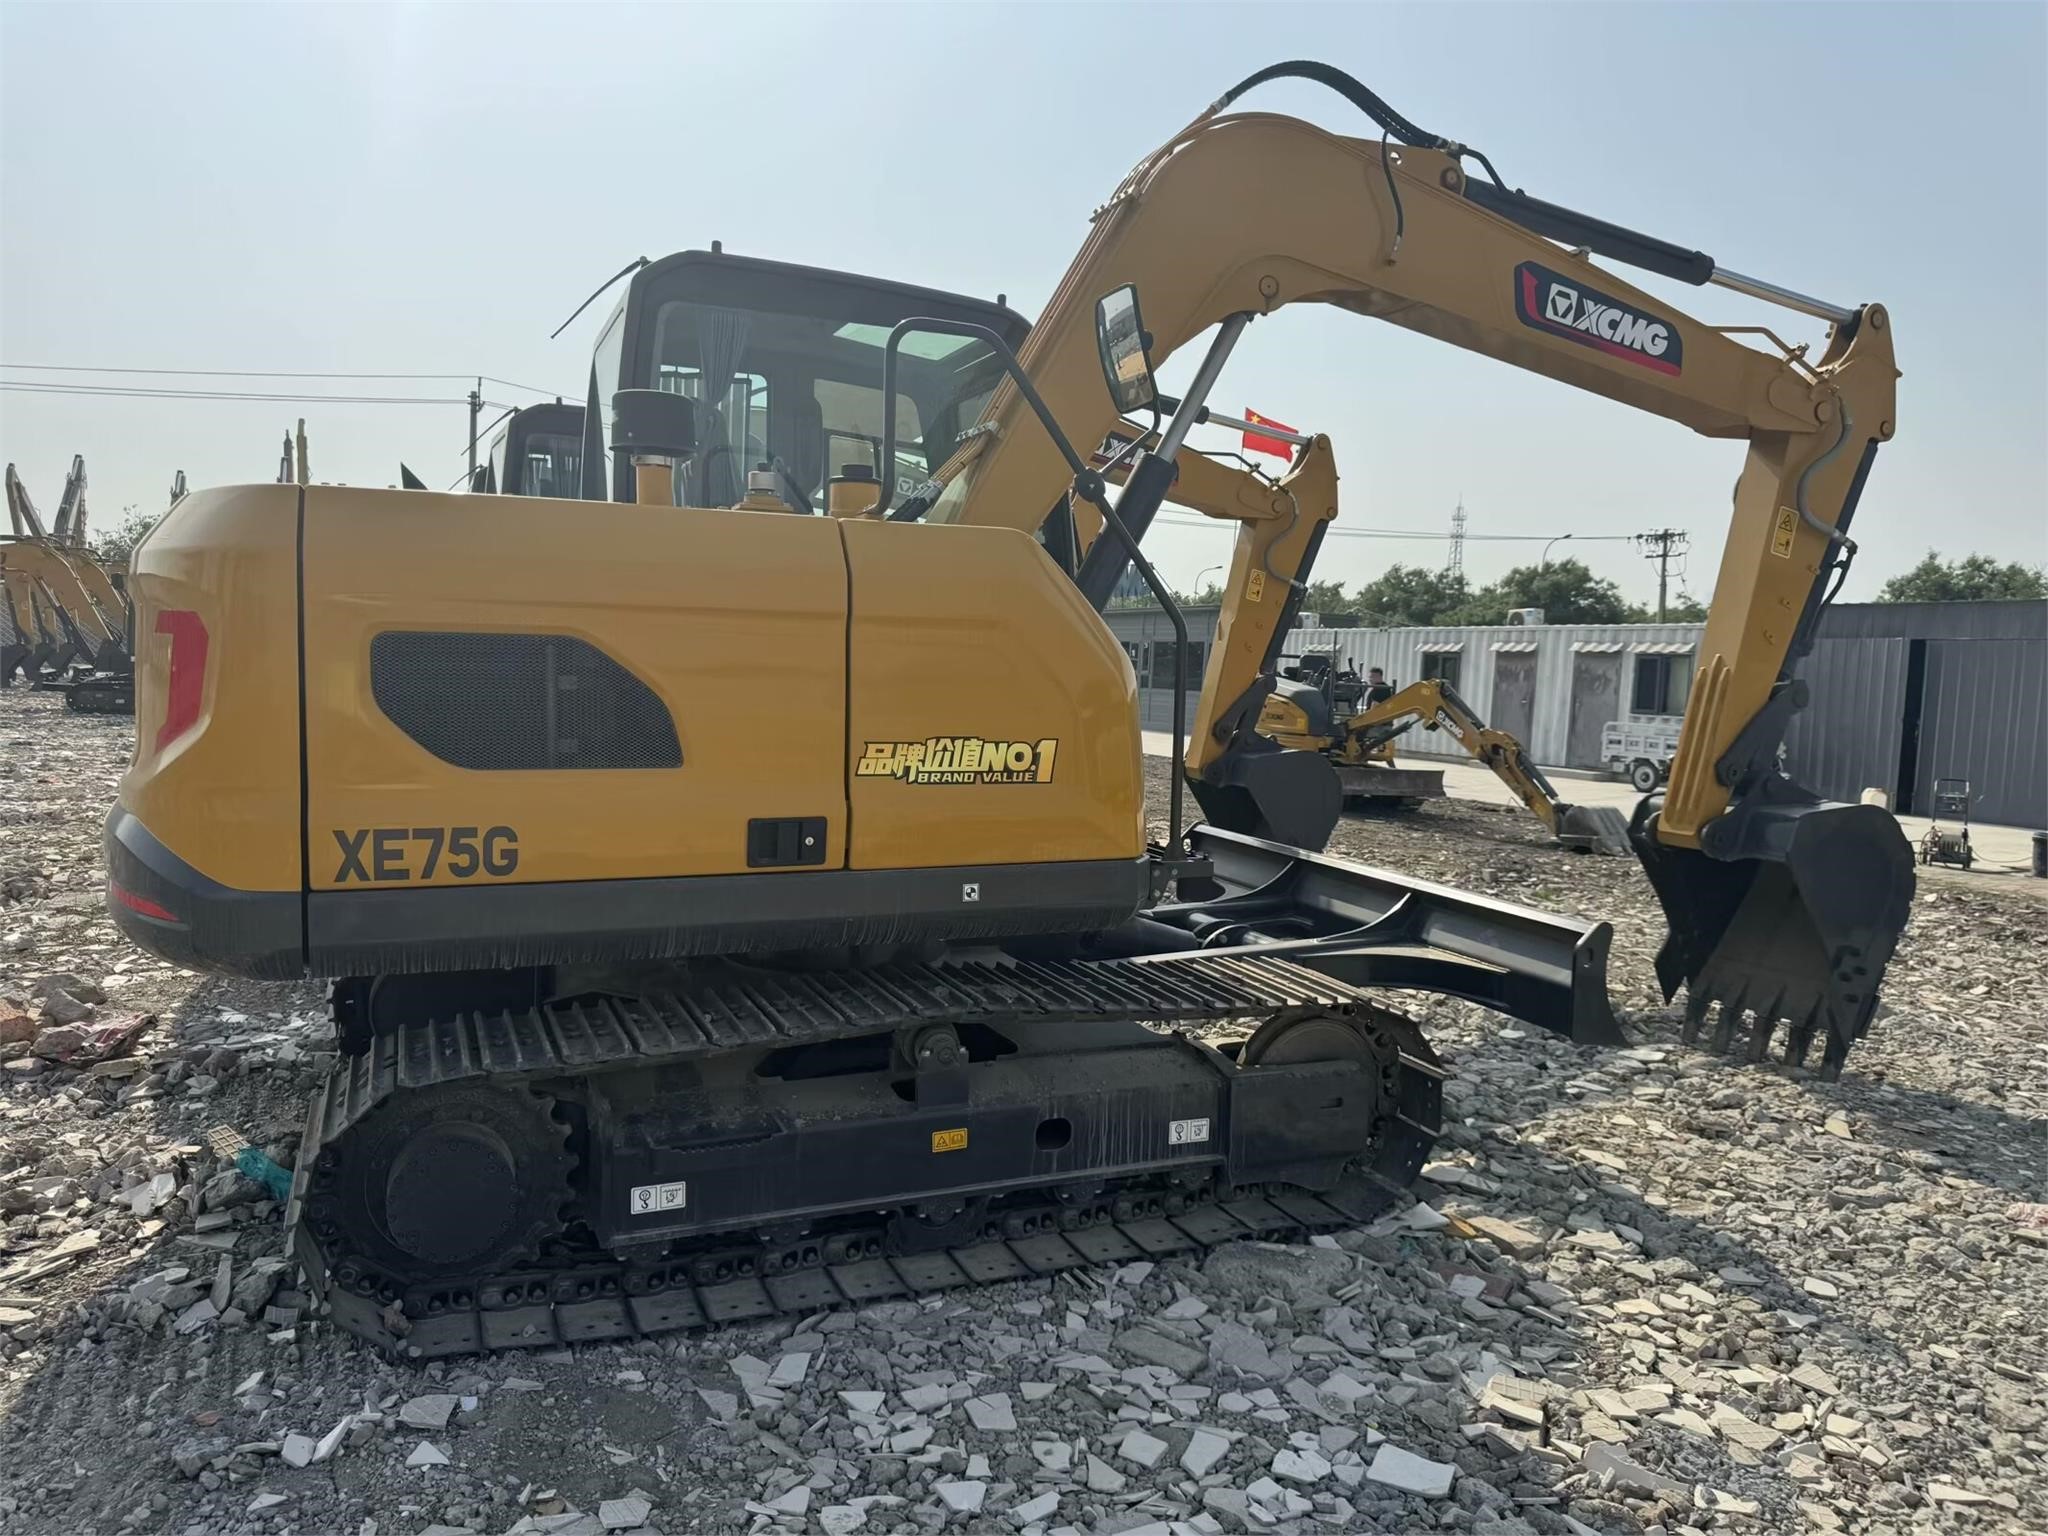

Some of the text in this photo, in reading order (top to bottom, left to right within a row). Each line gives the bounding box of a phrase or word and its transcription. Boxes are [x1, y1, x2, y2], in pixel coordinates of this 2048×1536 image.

[1571, 297, 1669, 356] XCMG
[917, 772, 1035, 784] BRAND VALUE
[332, 826, 518, 883] XE75G
